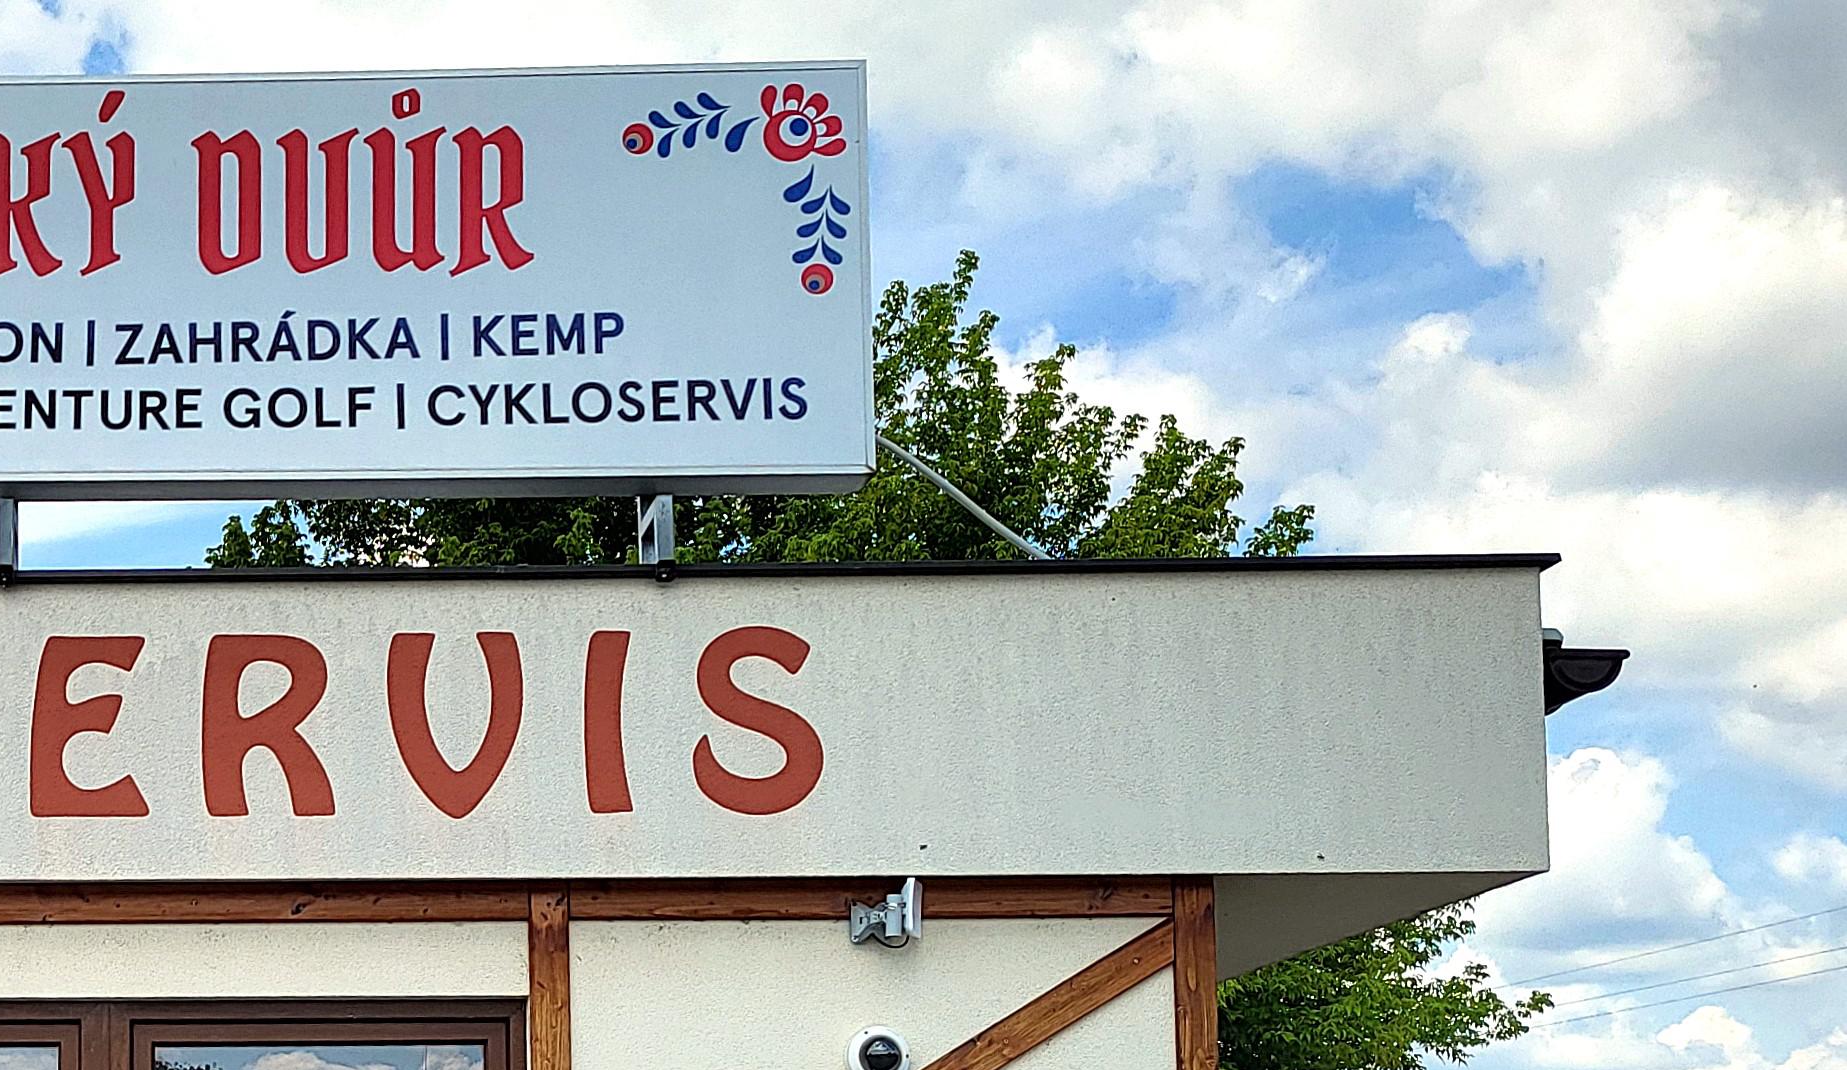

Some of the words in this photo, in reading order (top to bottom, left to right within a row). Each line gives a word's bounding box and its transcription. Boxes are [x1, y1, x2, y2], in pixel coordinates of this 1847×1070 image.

[192, 88, 534, 277] DVŮR
[114, 310, 421, 365] ZAHRÁDKA
[472, 312, 624, 358] KEMP
[223, 386, 375, 429] GOLF
[427, 377, 808, 426] CYKLOSERVIS
